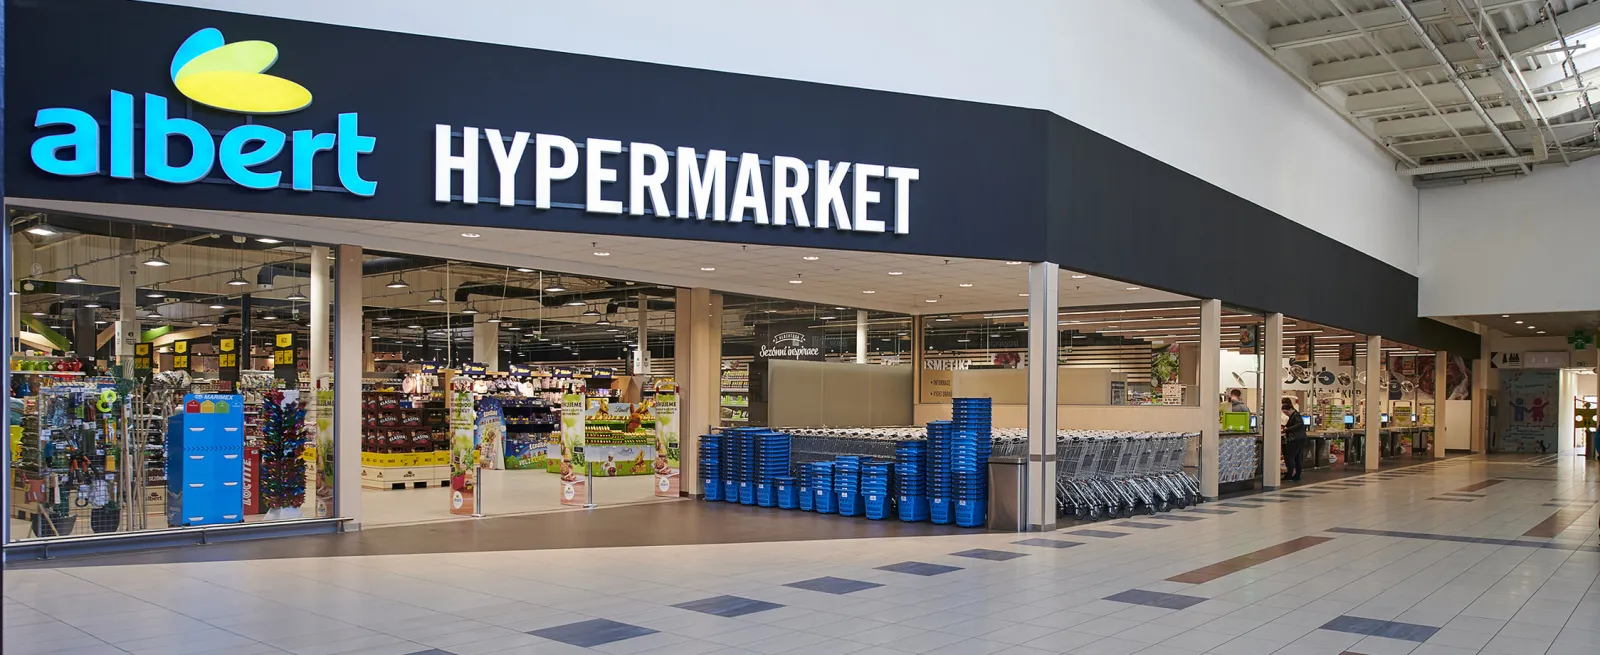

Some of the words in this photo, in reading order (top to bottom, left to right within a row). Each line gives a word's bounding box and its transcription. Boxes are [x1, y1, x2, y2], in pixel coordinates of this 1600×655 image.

[31, 89, 377, 197] albert
[435, 124, 919, 235] HYPERMARKET
[243, 459, 252, 506] LOCTITE
